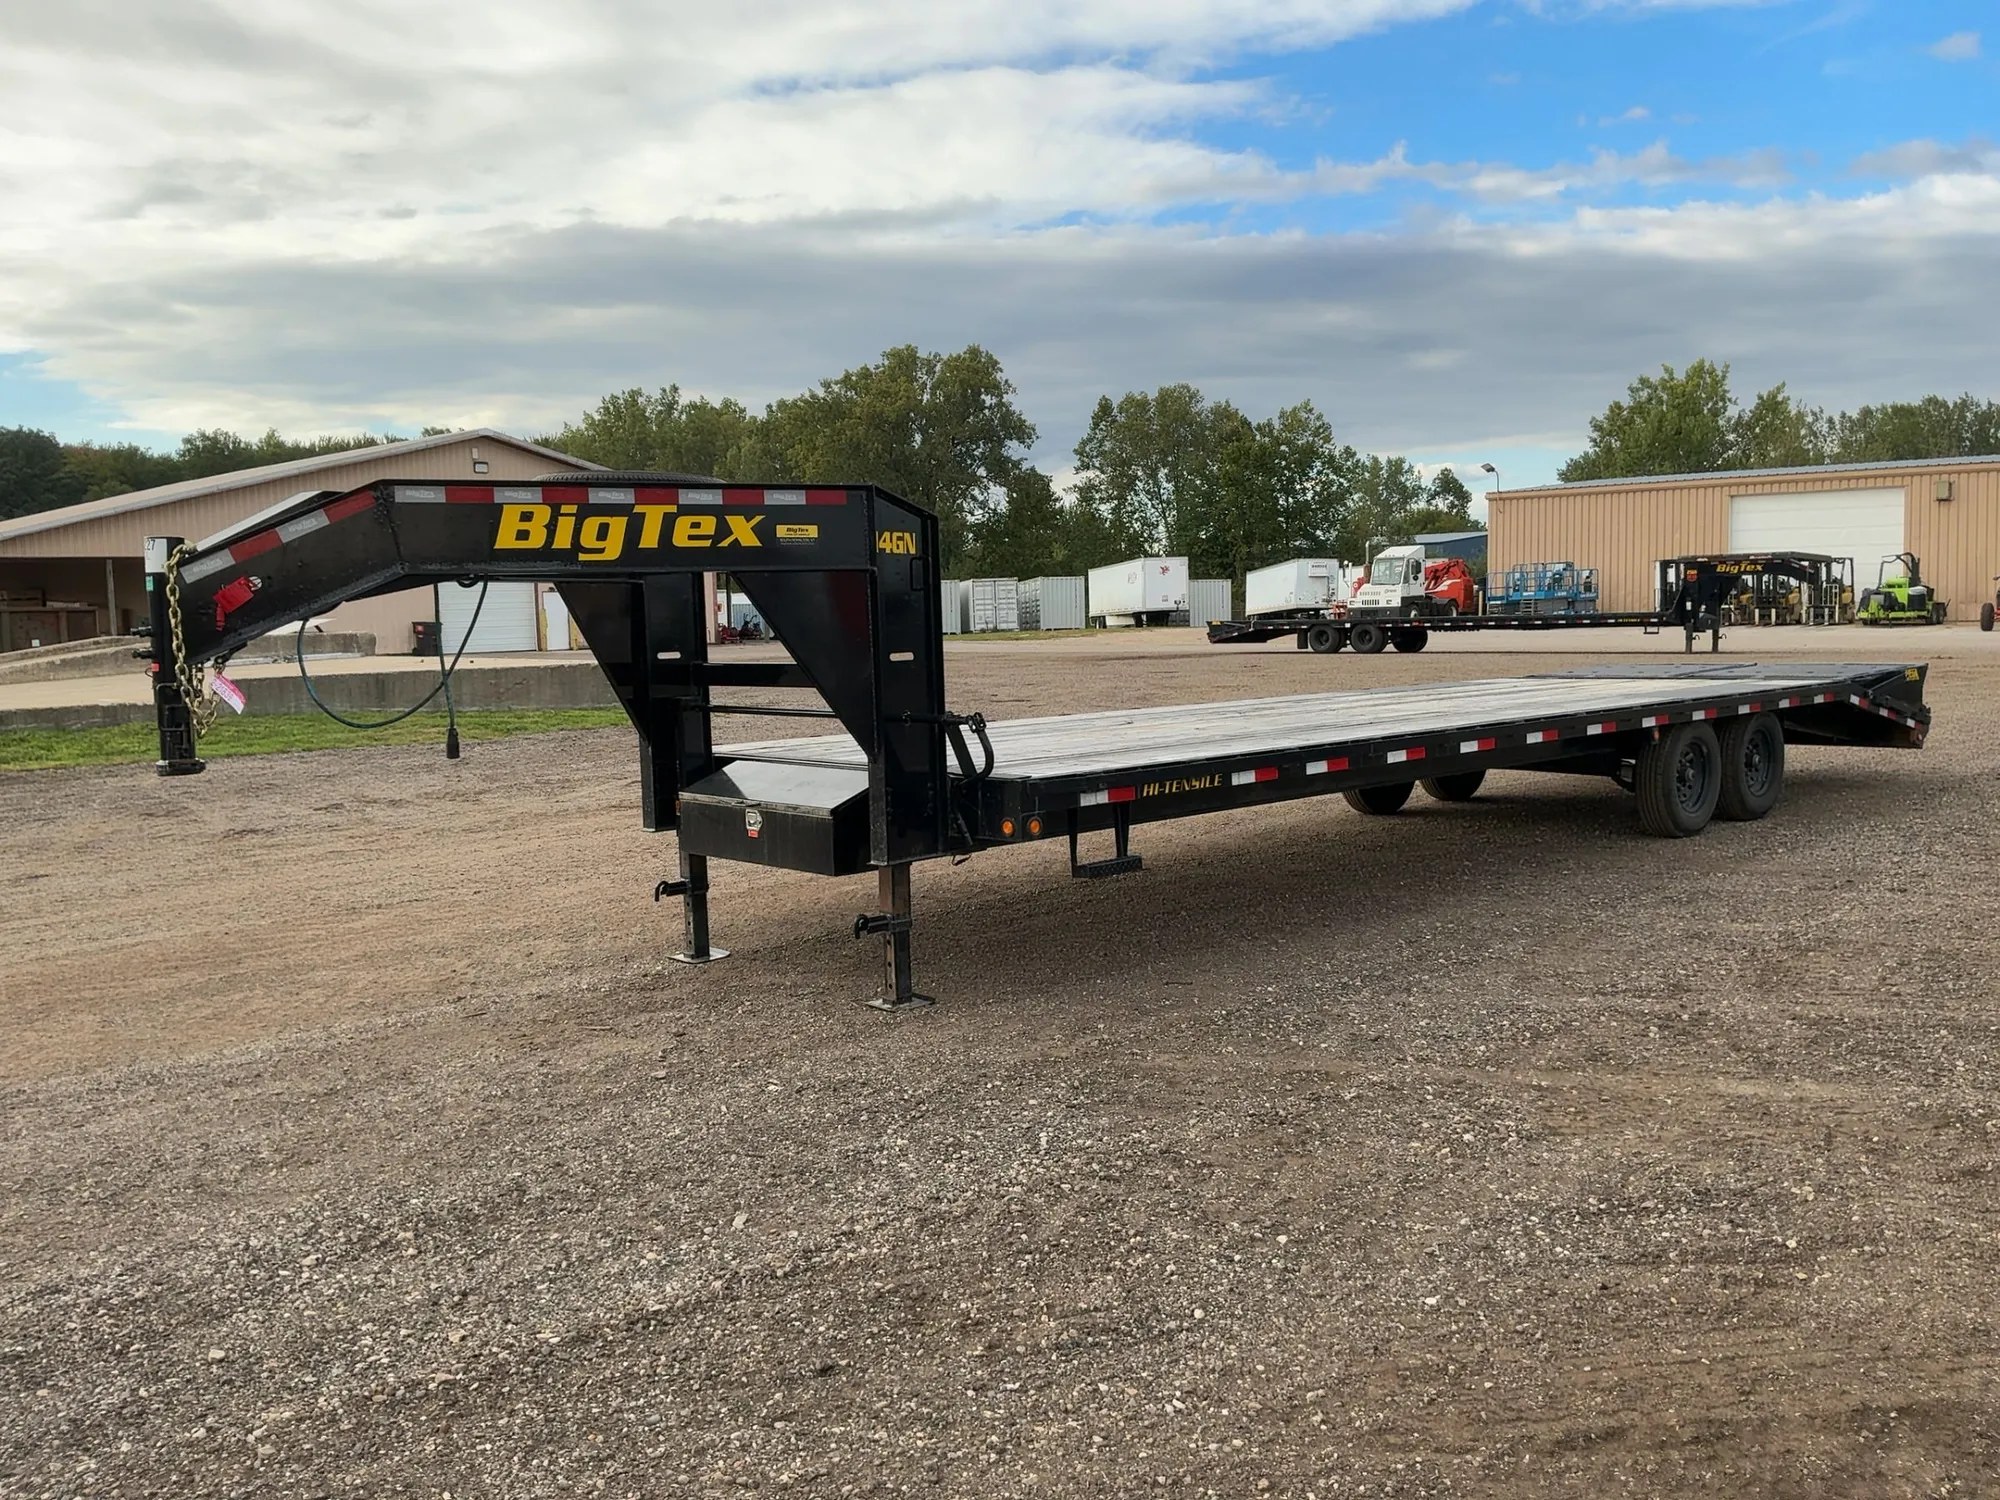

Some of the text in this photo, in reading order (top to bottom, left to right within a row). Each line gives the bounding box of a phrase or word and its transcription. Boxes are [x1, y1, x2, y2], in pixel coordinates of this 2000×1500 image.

[494, 504, 766, 561] BigTex
[1716, 563, 1764, 574] BigTex
[1143, 773, 1223, 797] HI-TENSILE
